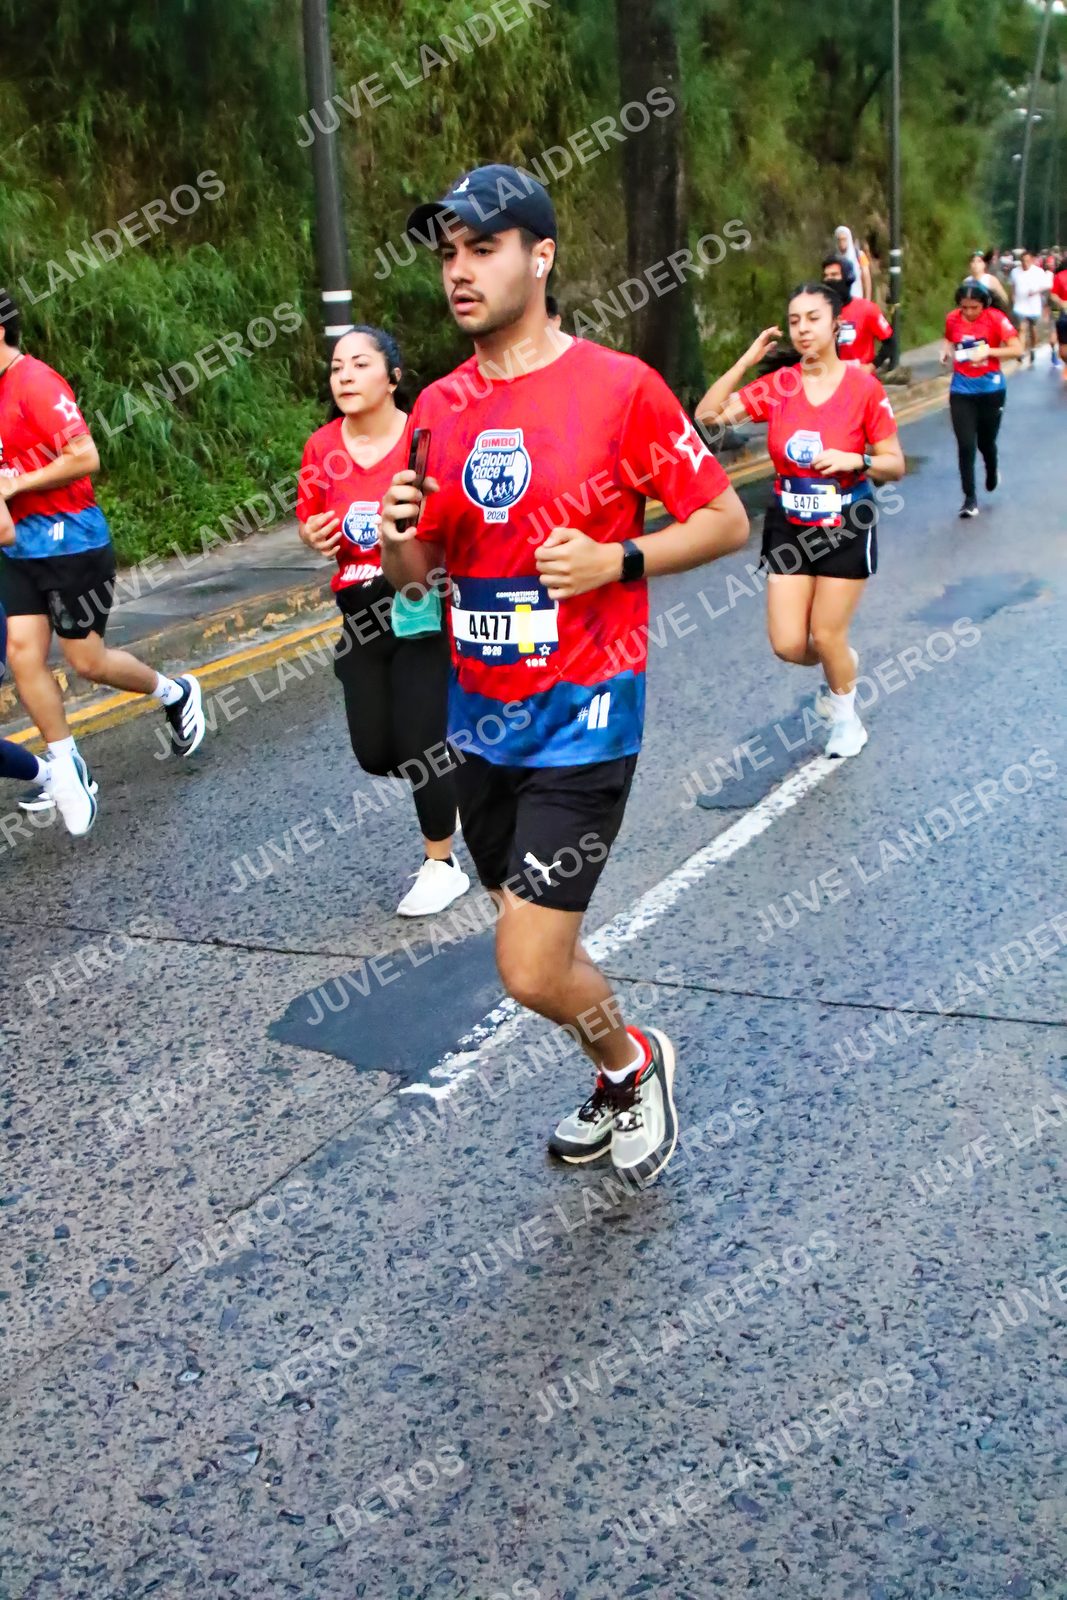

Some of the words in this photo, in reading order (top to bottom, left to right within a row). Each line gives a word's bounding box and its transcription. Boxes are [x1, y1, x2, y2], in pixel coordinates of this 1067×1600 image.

[481, 438, 516, 448] BIMBO
[480, 452, 515, 467] Global
[472, 466, 500, 480] Race
[794, 496, 820, 510] 5476
[486, 511, 507, 520] 2026
[469, 614, 511, 641] 4477
